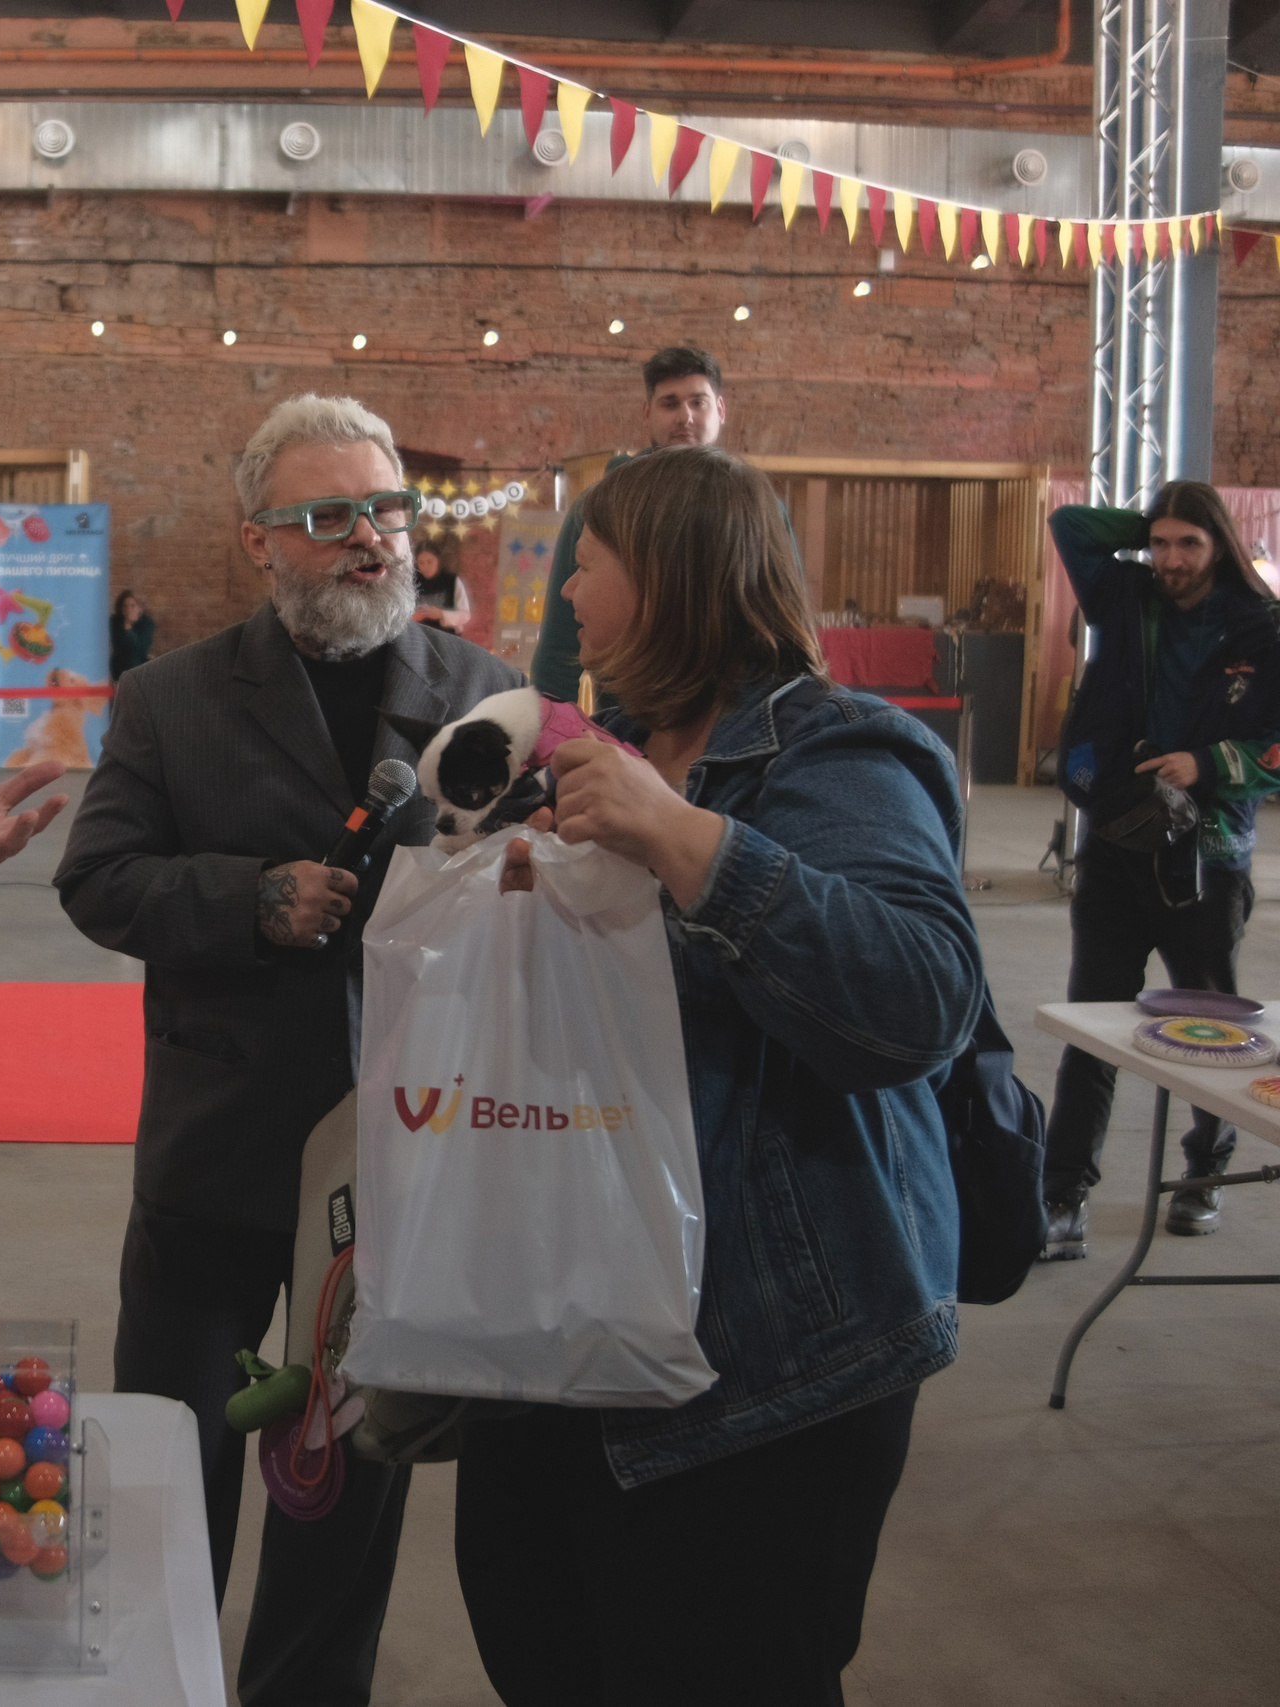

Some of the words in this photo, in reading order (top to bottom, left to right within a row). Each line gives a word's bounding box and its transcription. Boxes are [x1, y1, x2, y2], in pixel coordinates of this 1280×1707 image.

[455, 486, 520, 516] DELO
[48, 553, 76, 565] ДРУГ
[46, 566, 102, 578] ПИТОМЦА
